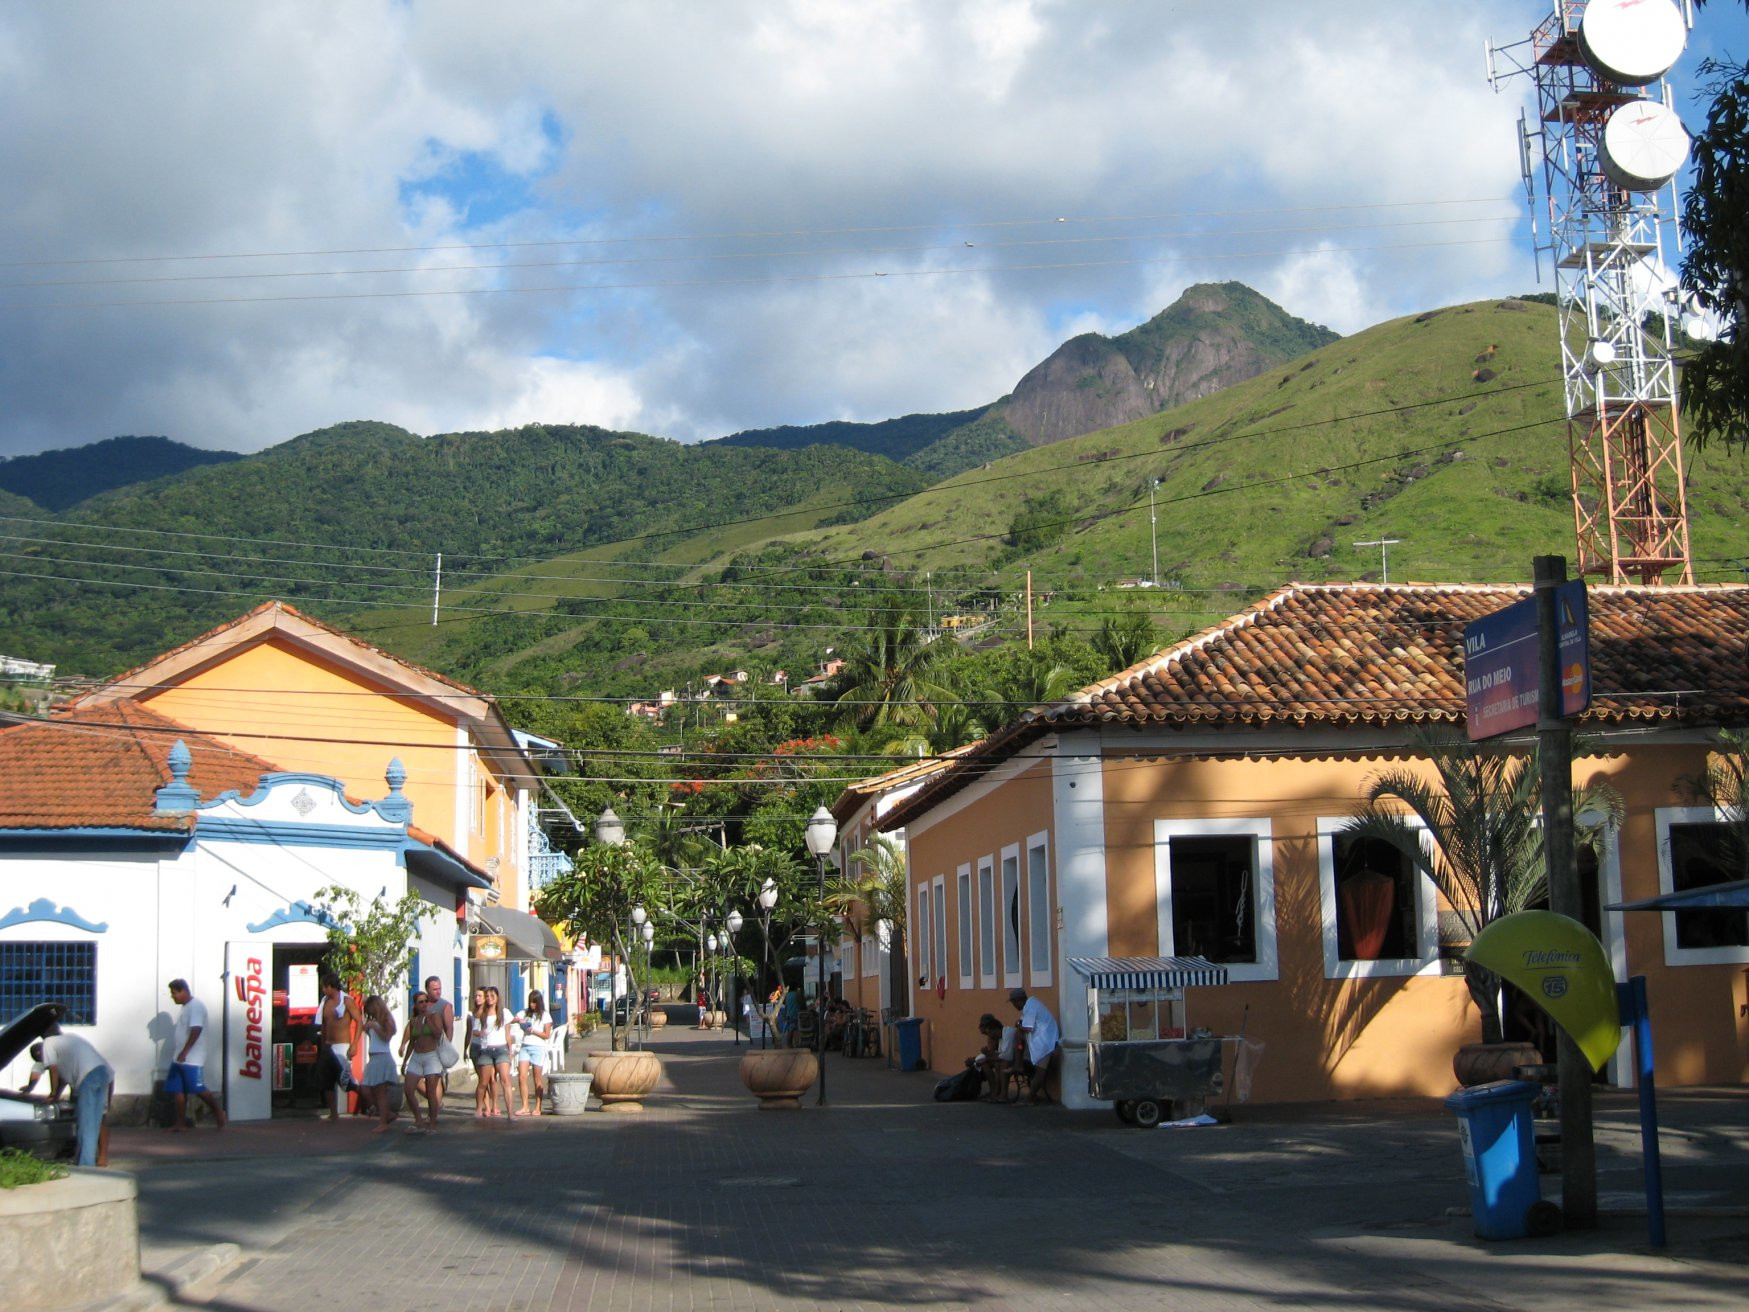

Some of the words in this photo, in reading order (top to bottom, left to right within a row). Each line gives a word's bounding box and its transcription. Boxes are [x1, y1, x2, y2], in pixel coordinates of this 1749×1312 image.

[1466, 633, 1486, 654] VILA
[1468, 677, 1481, 695] RUA
[1482, 673, 1493, 689] DO
[1493, 666, 1512, 685] MEIO
[240, 957, 267, 1080] banespa
